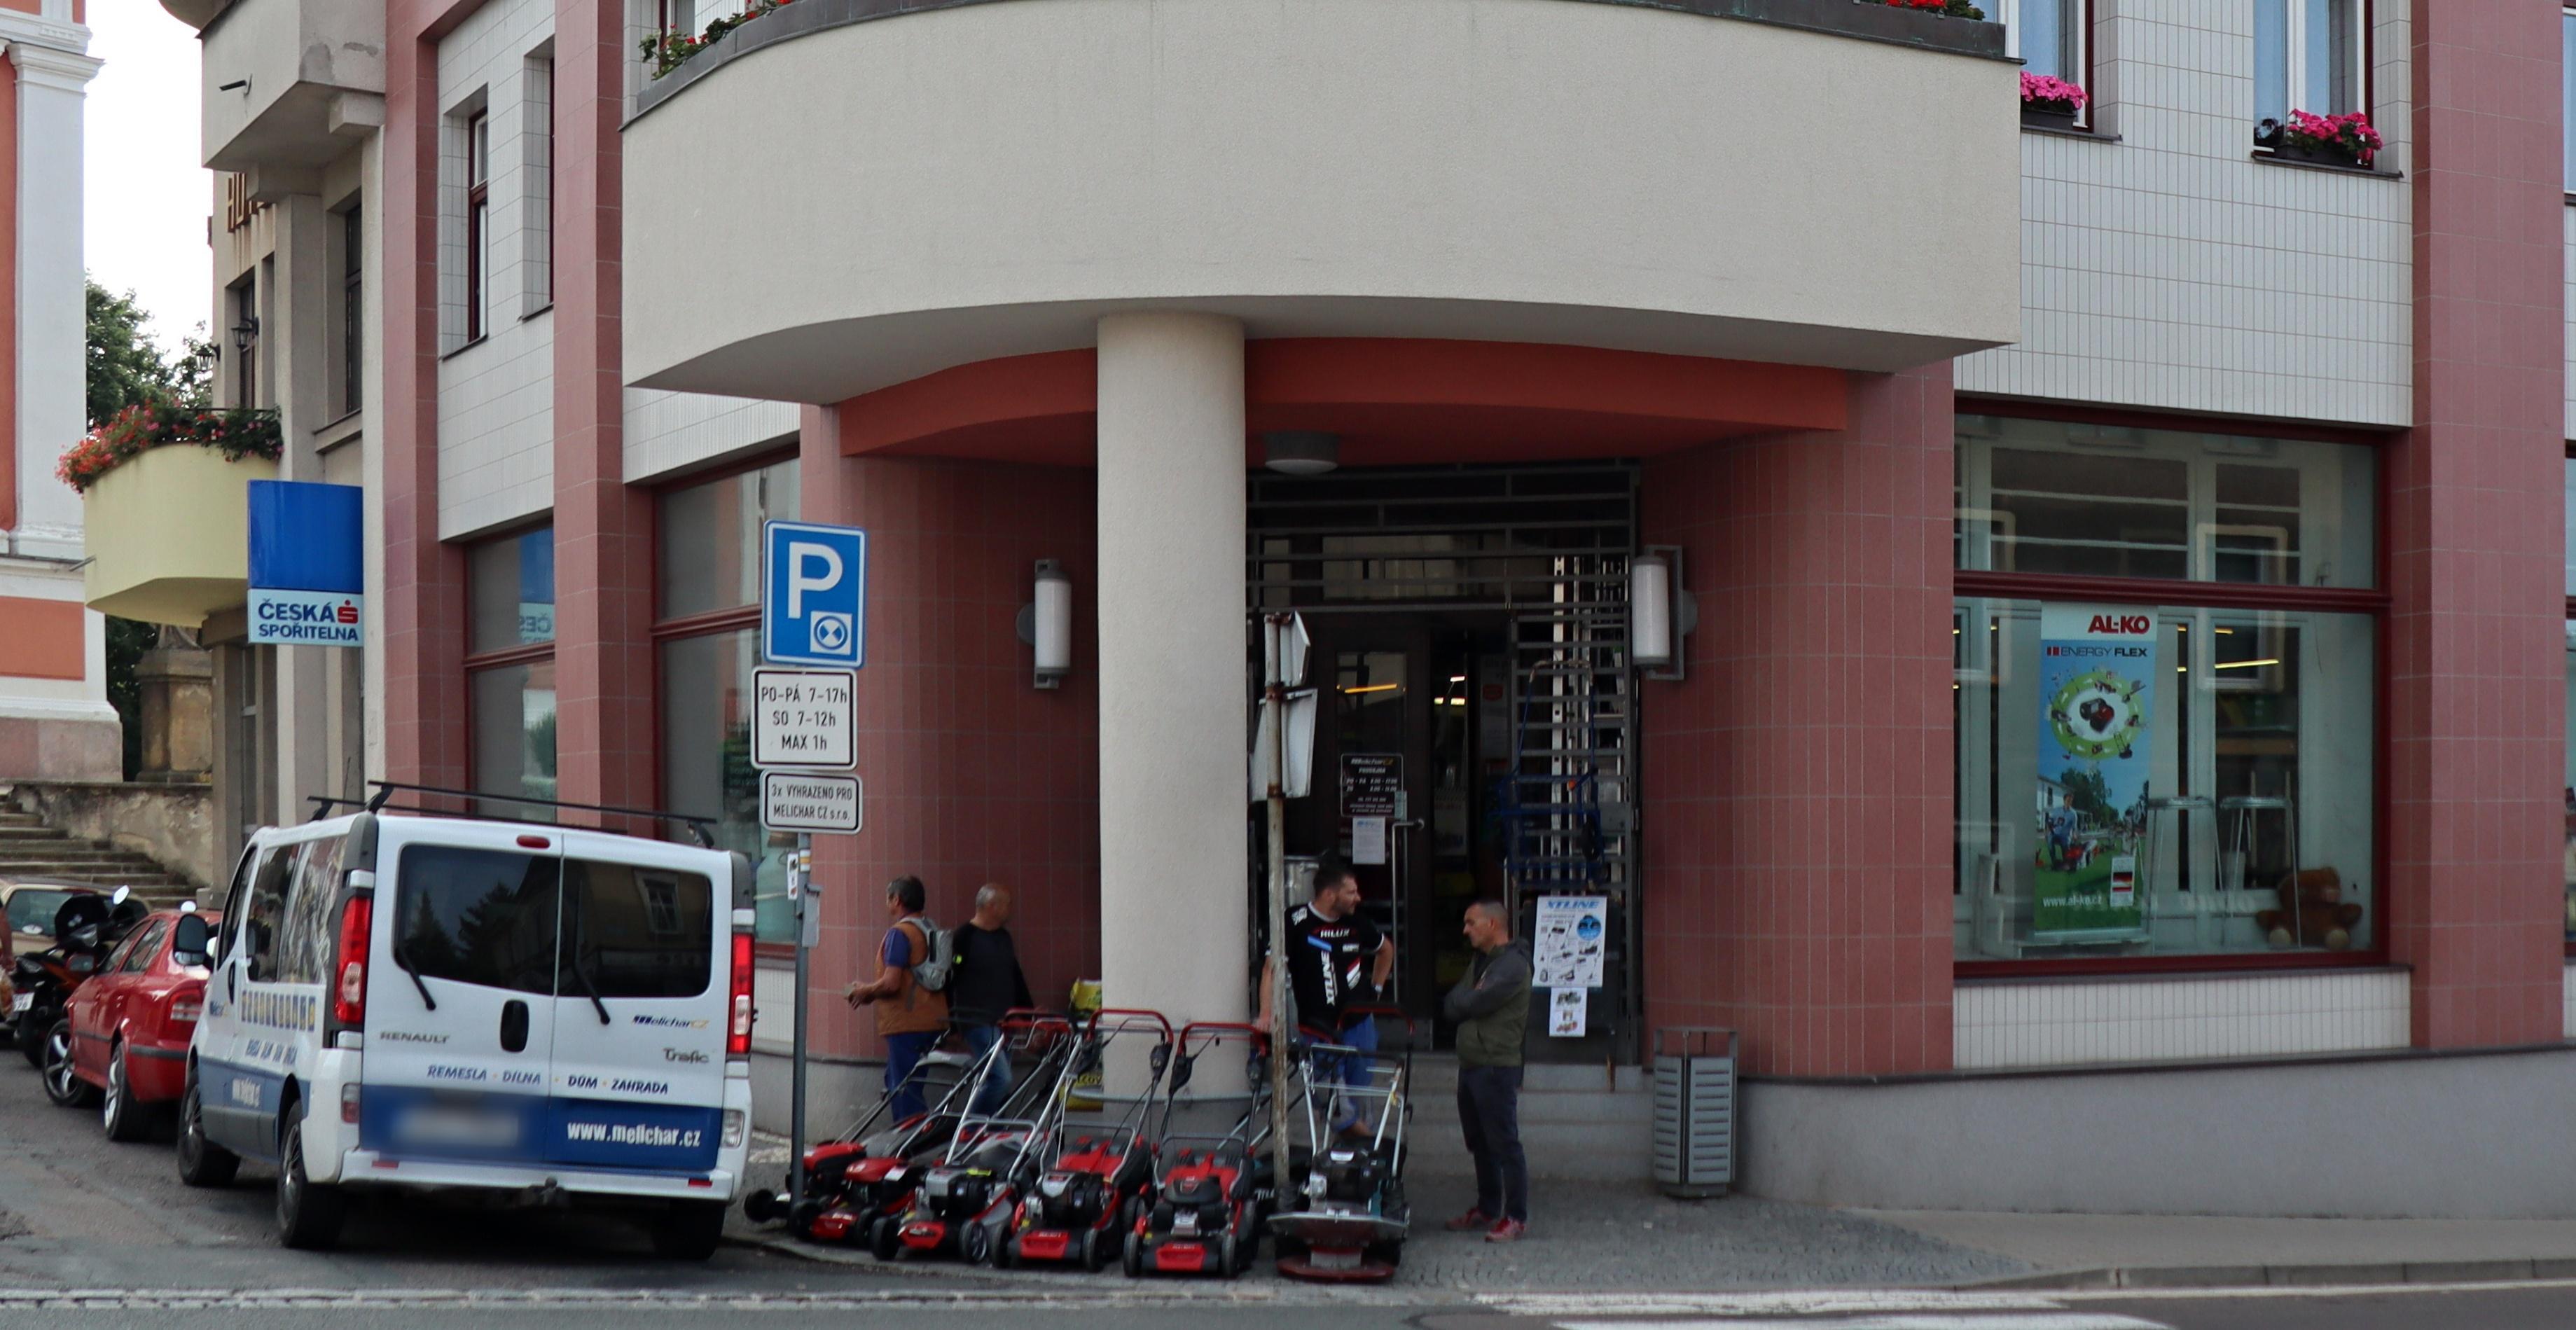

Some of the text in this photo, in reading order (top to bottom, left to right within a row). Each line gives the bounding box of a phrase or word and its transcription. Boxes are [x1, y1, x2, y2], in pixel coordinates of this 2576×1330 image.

[788, 541, 843, 619] P
[258, 599, 335, 623] ČESKÁ
[258, 623, 359, 642] SPOŘITELNA
[2088, 615, 2150, 635] AL-KO
[2061, 646, 2148, 658] ENERGY FLEX
[761, 684, 847, 704] PO-PÁ 7-17h
[773, 710, 836, 727] SO 7-12h
[781, 735, 827, 750] MAX 1h
[772, 784, 852, 801] 3x VYHRAZENO PRO
[773, 804, 850, 821] MELICHAR CZ s.r.o.
[1320, 929, 1350, 938] HILUX
[380, 1032, 450, 1044] RENAULT
[663, 1047, 709, 1064] Trafic
[427, 1064, 487, 1081] REMESLA
[611, 1078, 668, 1095] ZAHRADA
[567, 1122, 701, 1147] www.melichar.cz
